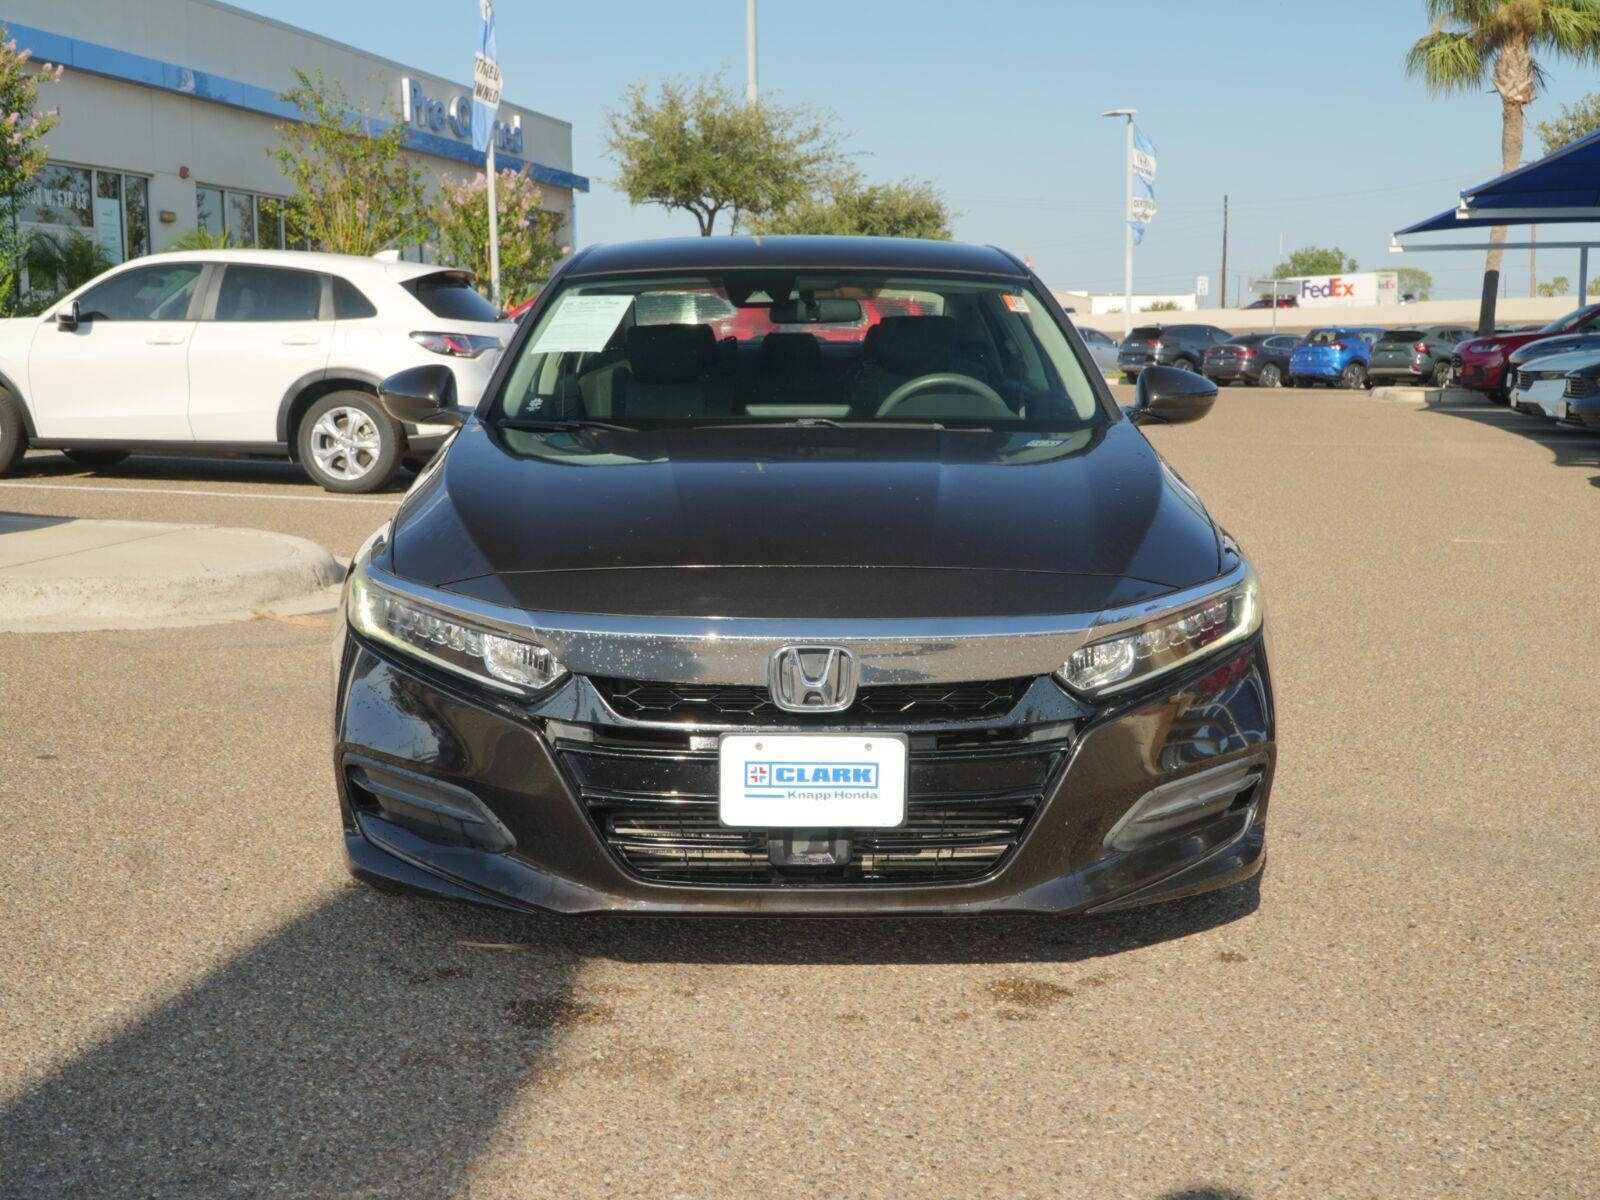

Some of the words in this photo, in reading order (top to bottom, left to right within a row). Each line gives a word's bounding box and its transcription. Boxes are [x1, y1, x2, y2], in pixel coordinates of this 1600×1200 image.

[402, 78, 523, 153] Pre-Oned
[1301, 278, 1354, 298] FedEx
[775, 767, 872, 783] CLARK
[787, 791, 831, 801] Knapp
[834, 791, 878, 800] Honda
